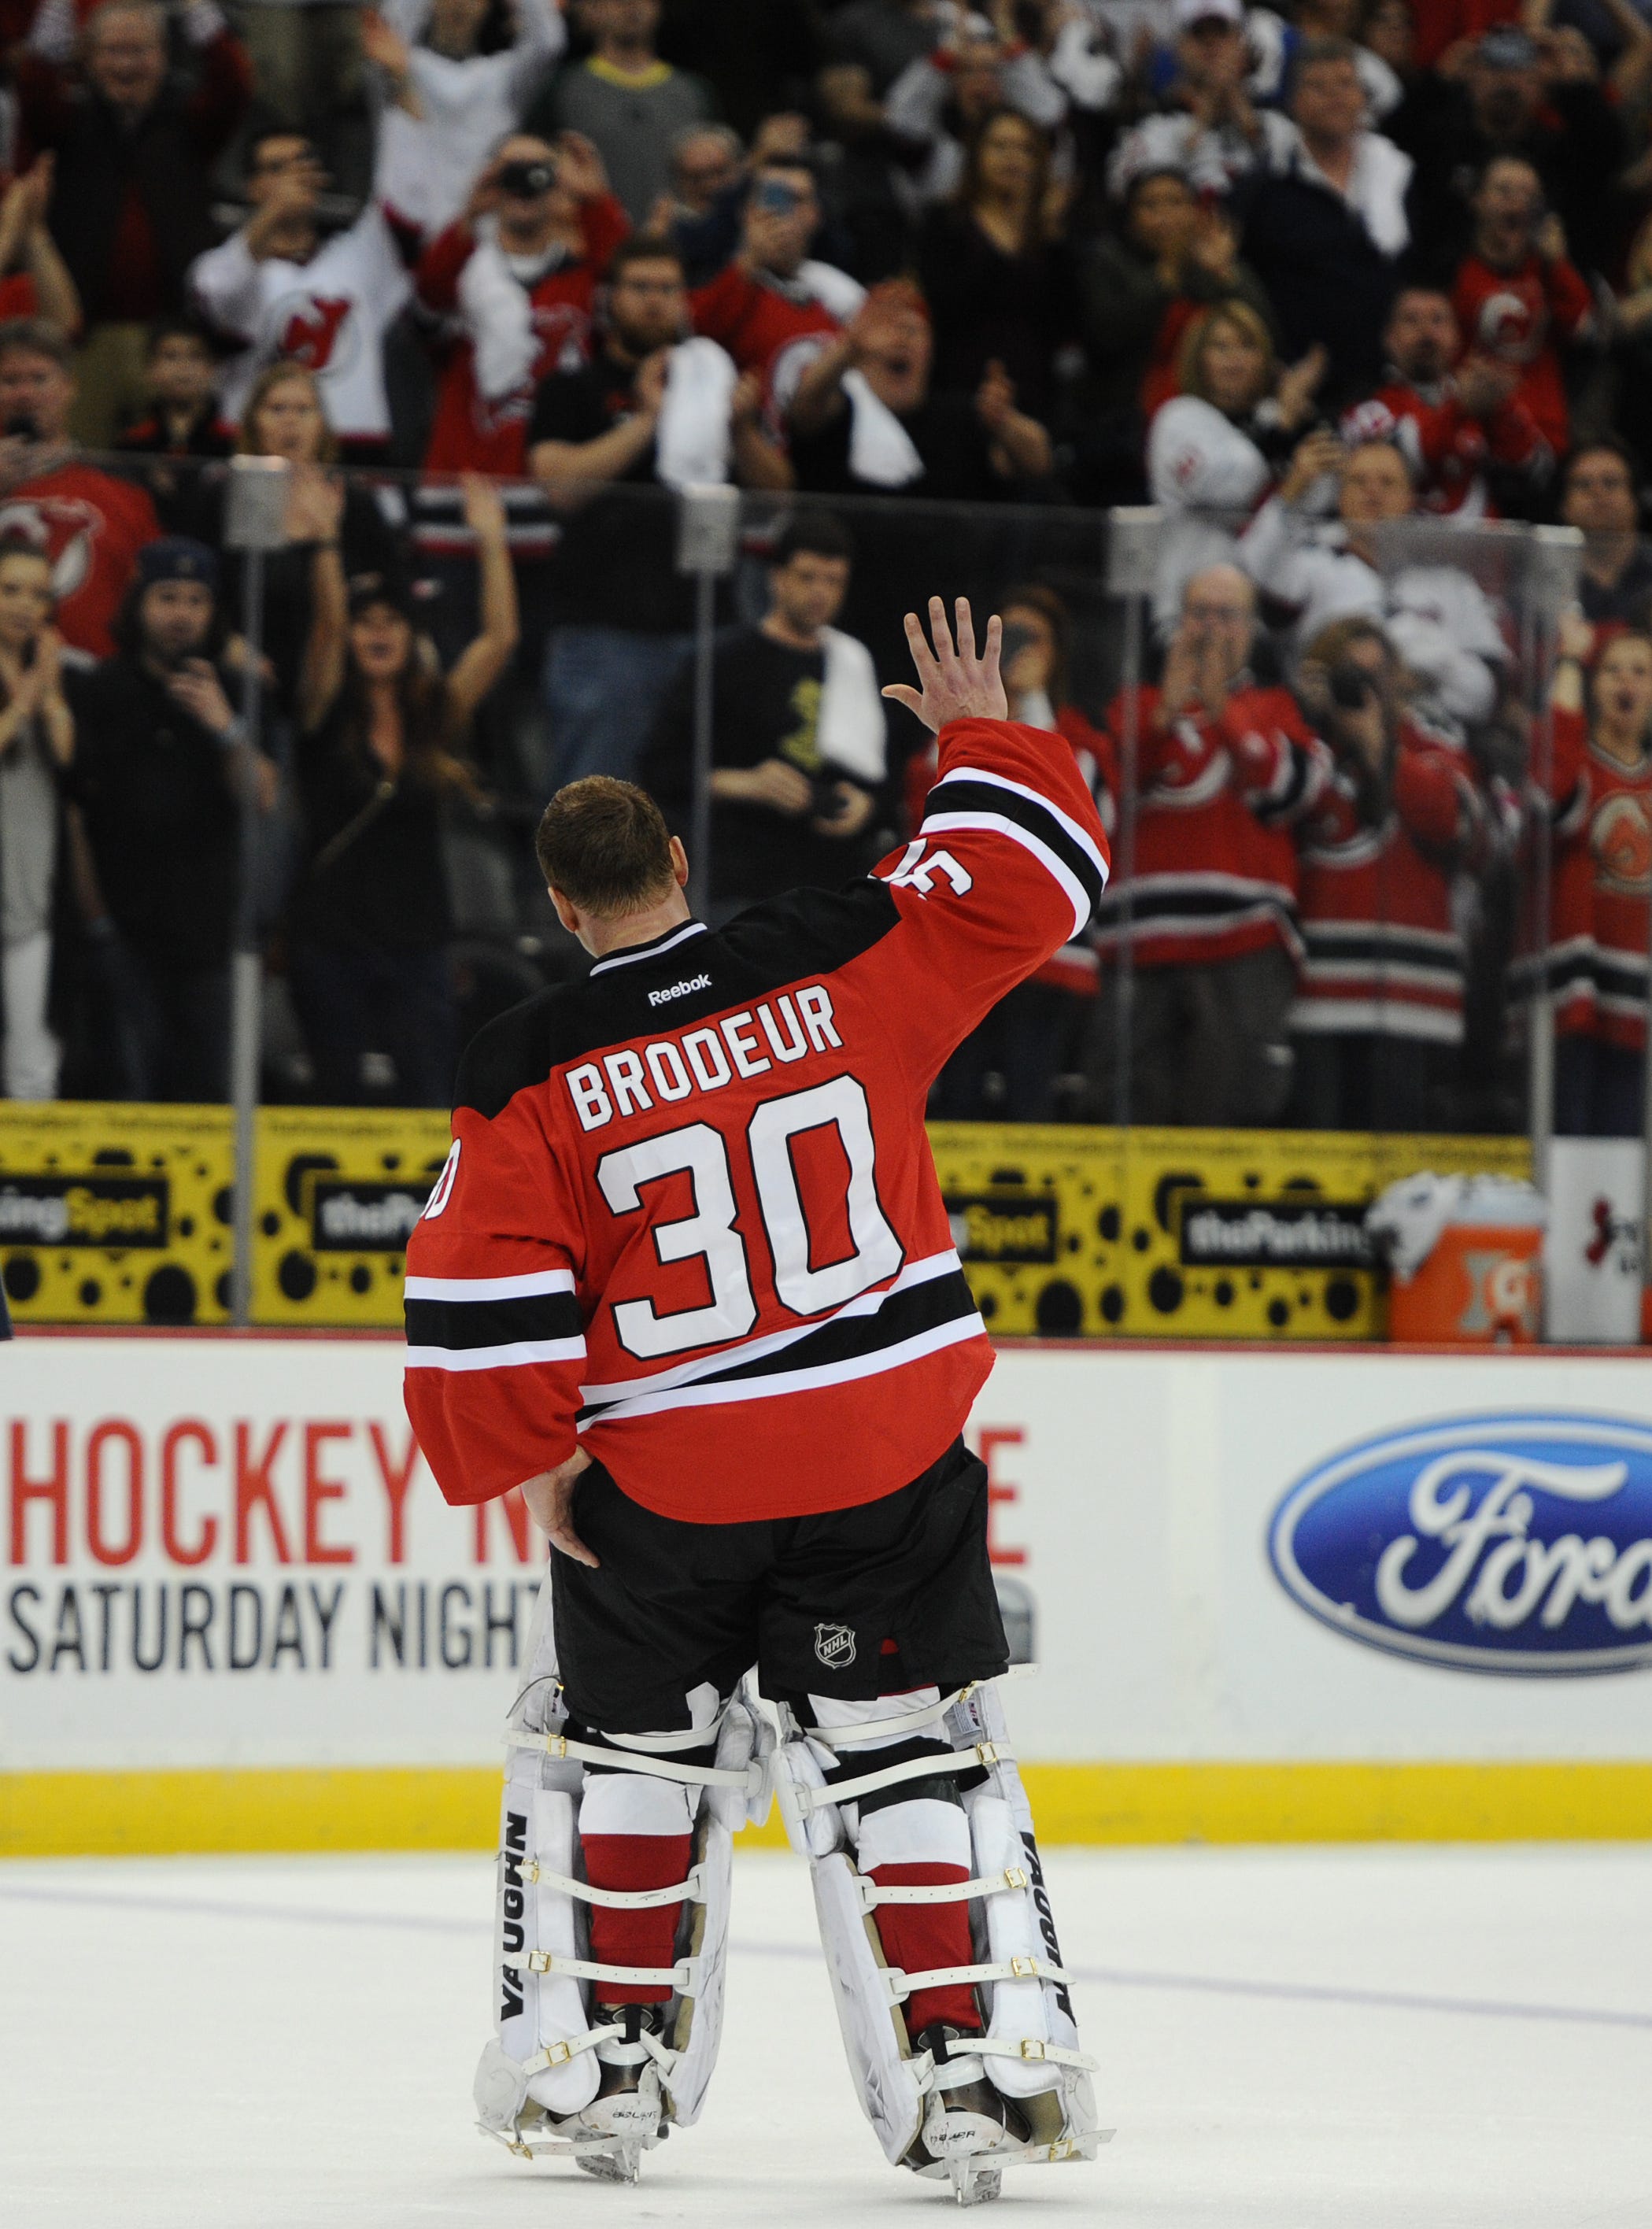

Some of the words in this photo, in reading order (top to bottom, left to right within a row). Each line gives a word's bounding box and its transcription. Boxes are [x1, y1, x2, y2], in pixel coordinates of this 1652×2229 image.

[648, 973, 712, 1007] Reebok
[565, 984, 844, 1133] BRODEUR
[594, 1071, 907, 1362] 30
[9, 1418, 419, 1566] HOCKEY
[9, 1583, 344, 1673] SATURDAY
[371, 1582, 542, 1670] NIGH
[822, 1635, 848, 1657] NHL
